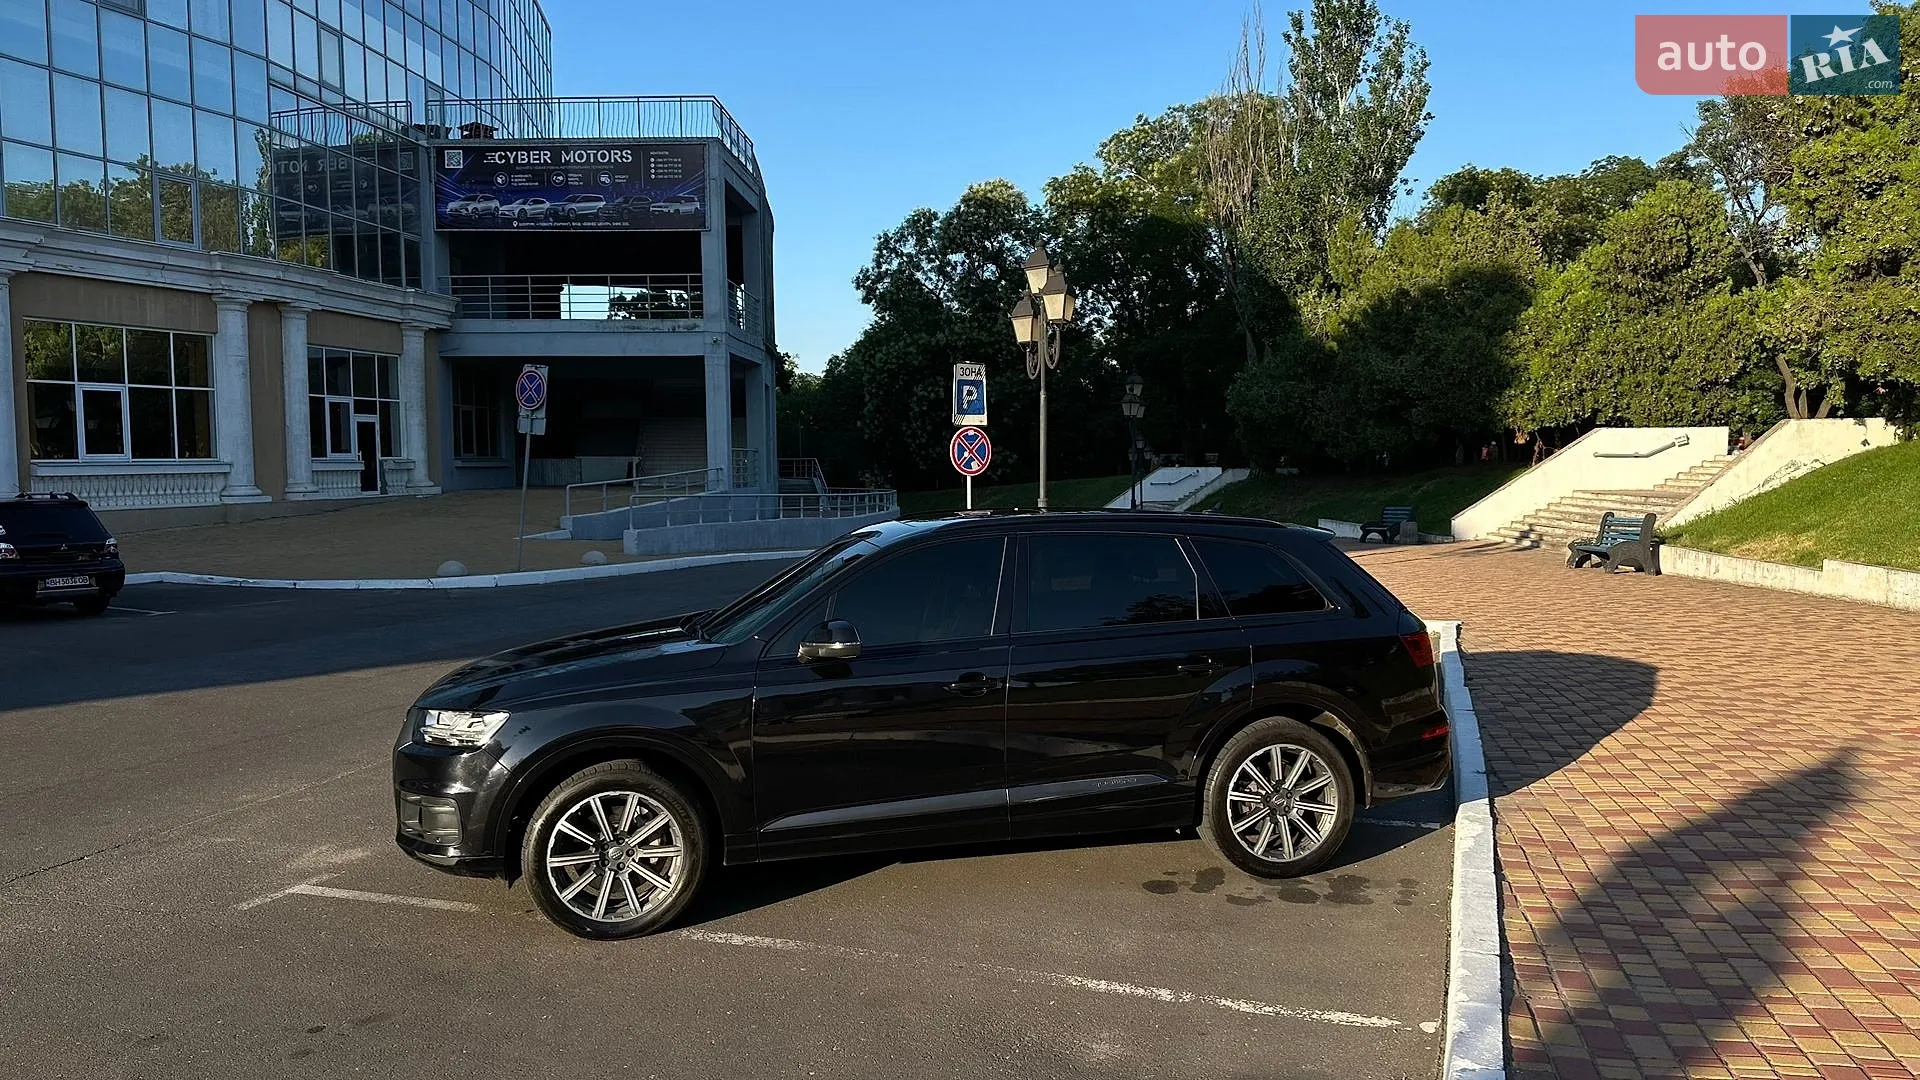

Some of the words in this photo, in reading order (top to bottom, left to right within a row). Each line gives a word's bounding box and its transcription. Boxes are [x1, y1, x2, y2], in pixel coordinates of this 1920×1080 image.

[495, 150, 552, 165] CYBER
[561, 149, 632, 164] MOTORS
[959, 366, 983, 377] ЗОНА
[962, 385, 978, 409] P
